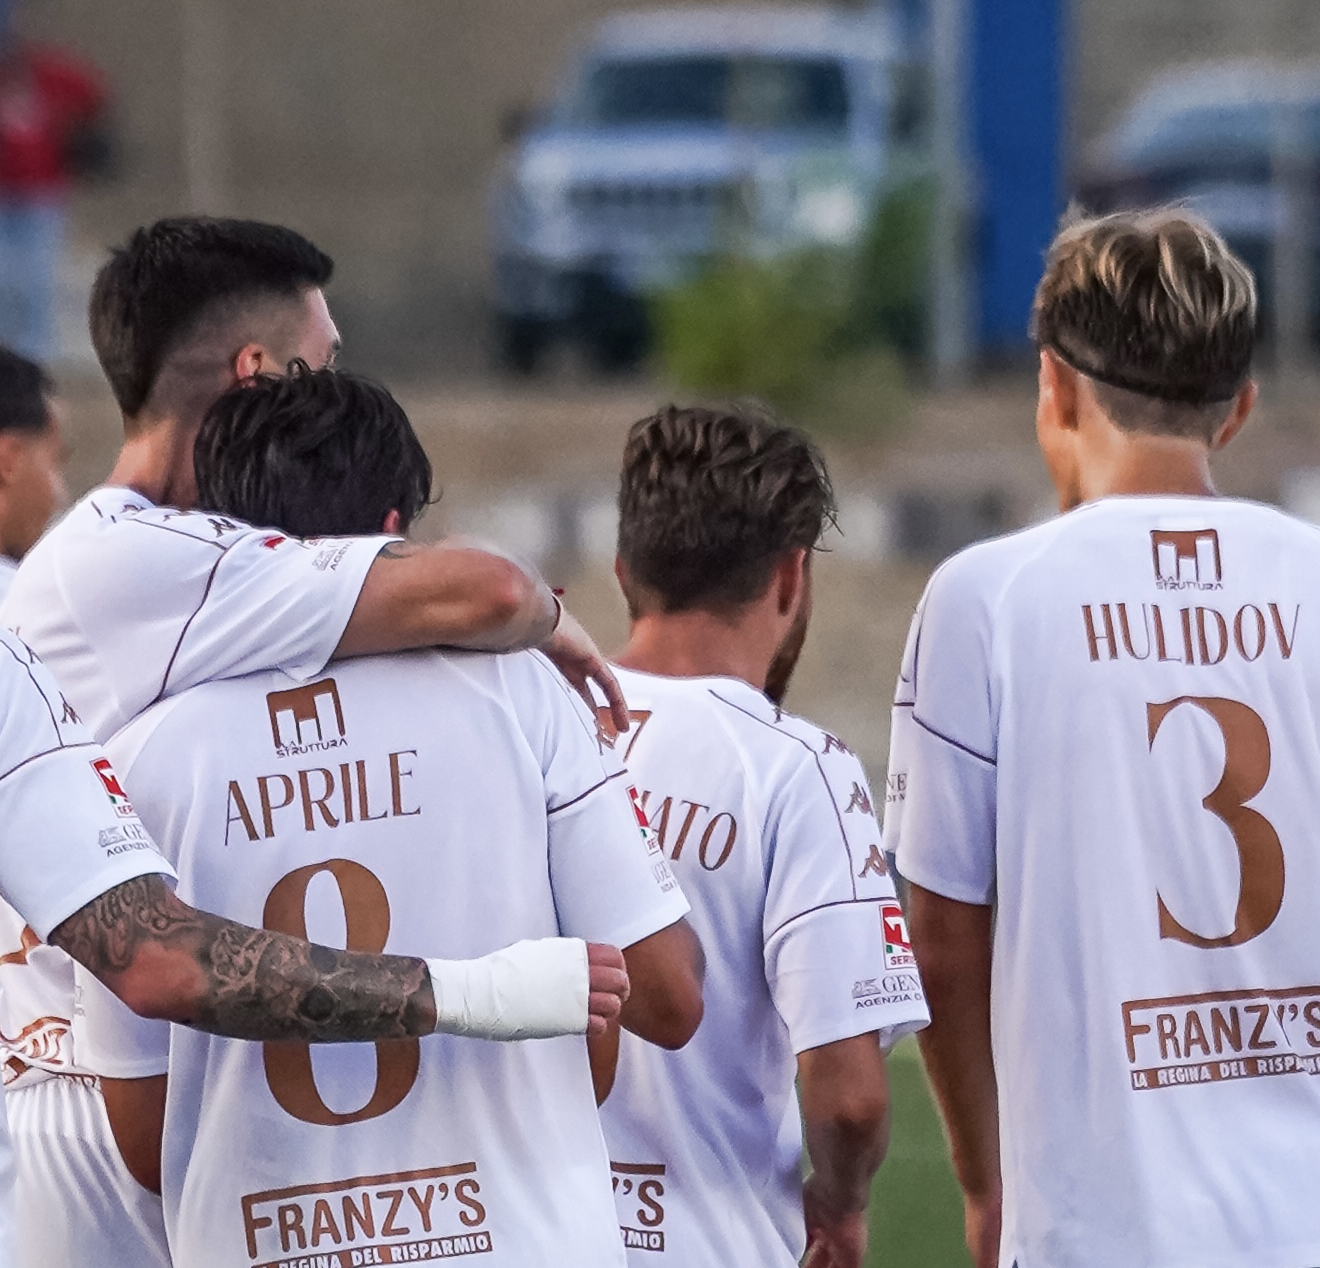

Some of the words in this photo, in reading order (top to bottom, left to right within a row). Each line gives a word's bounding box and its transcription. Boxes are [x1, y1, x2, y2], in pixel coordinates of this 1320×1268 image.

[1081, 603, 1300, 665] HULIDOV
[224, 750, 421, 845] APRILE
[642, 790, 737, 871] ATO
[1146, 696, 1285, 949] 3
[263, 858, 421, 1126] 8
[855, 994, 911, 1009] AGENZIA
[1133, 1072, 1148, 1087] LA
[1157, 1067, 1212, 1085] REGINA
[1220, 1062, 1247, 1078] DEL
[241, 1162, 486, 1259] FRANZY'S
[351, 1247, 382, 1267] DEL
[391, 1234, 489, 1263] RISPARMIO
